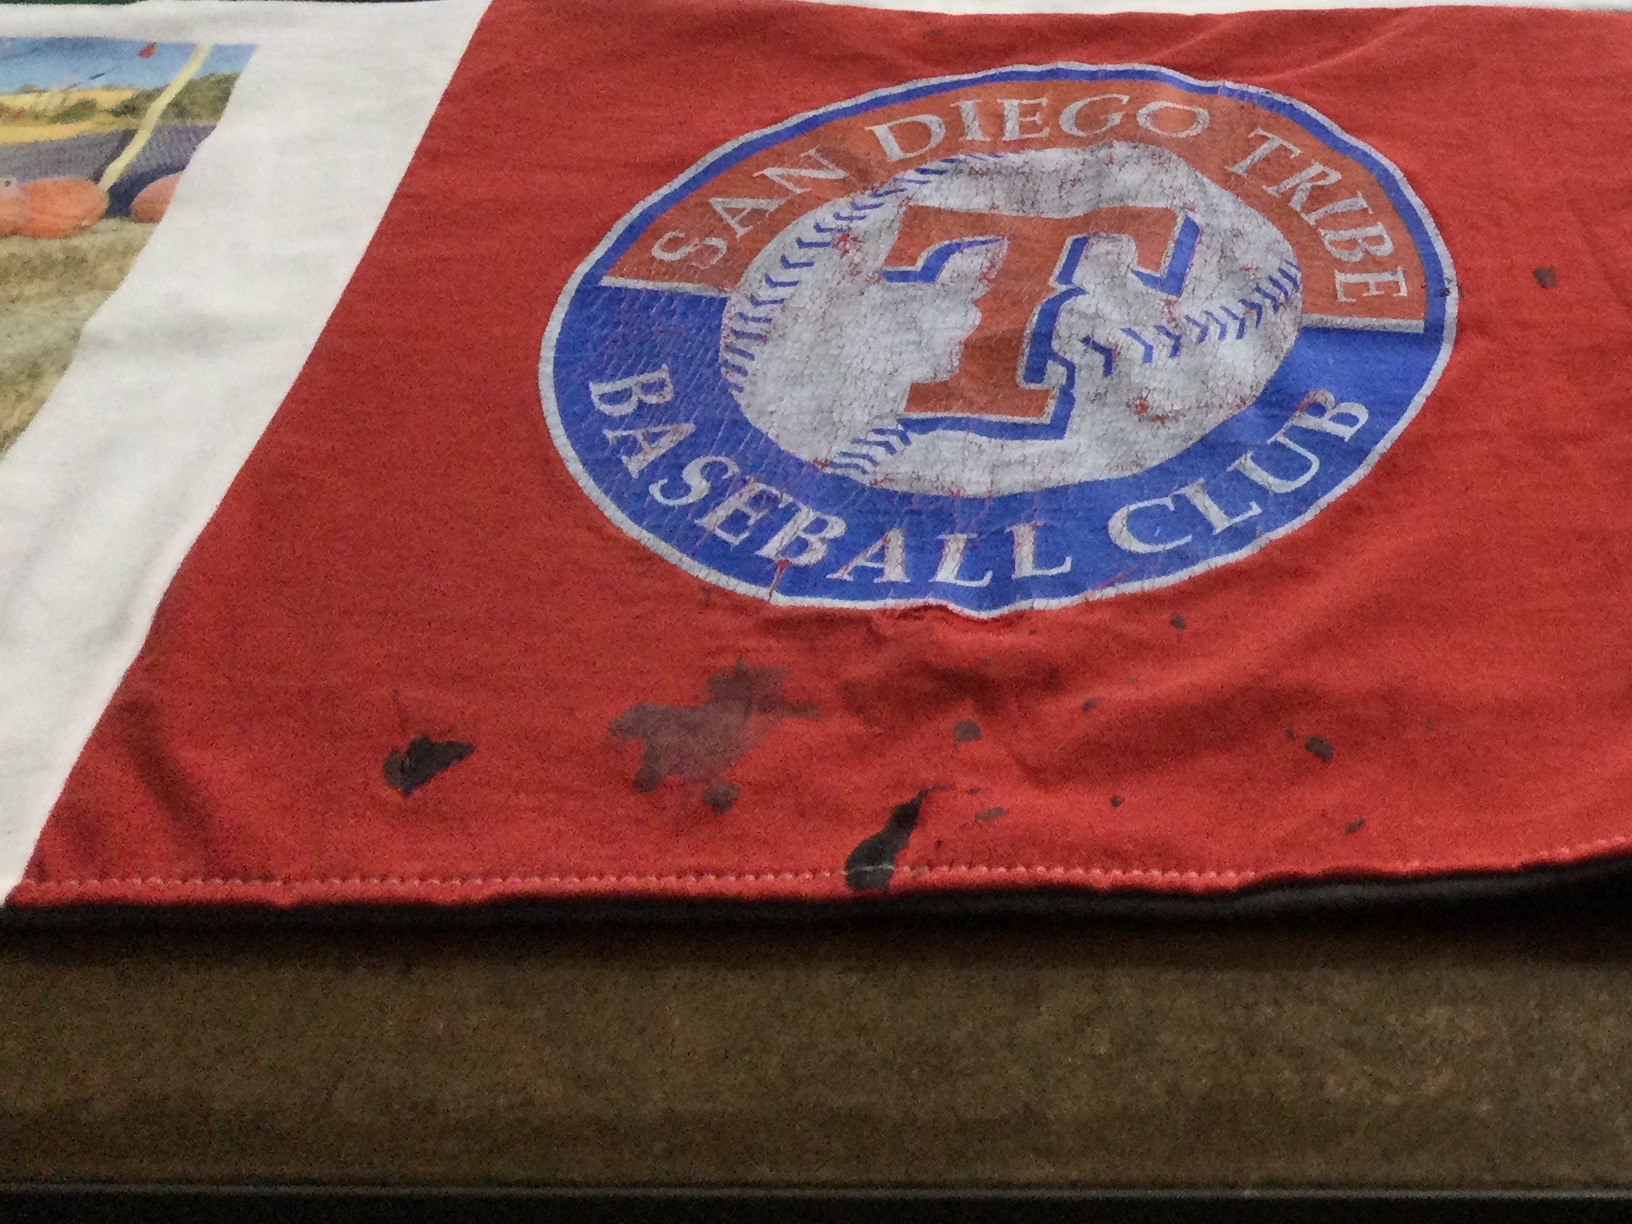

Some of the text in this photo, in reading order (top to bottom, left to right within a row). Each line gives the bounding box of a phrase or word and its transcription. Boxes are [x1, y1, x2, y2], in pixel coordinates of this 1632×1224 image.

[651, 92, 1410, 305] SAN DIEGO TRIBE
[880, 204, 1203, 440] T
[590, 363, 1370, 589] BASEBALL CLUB
